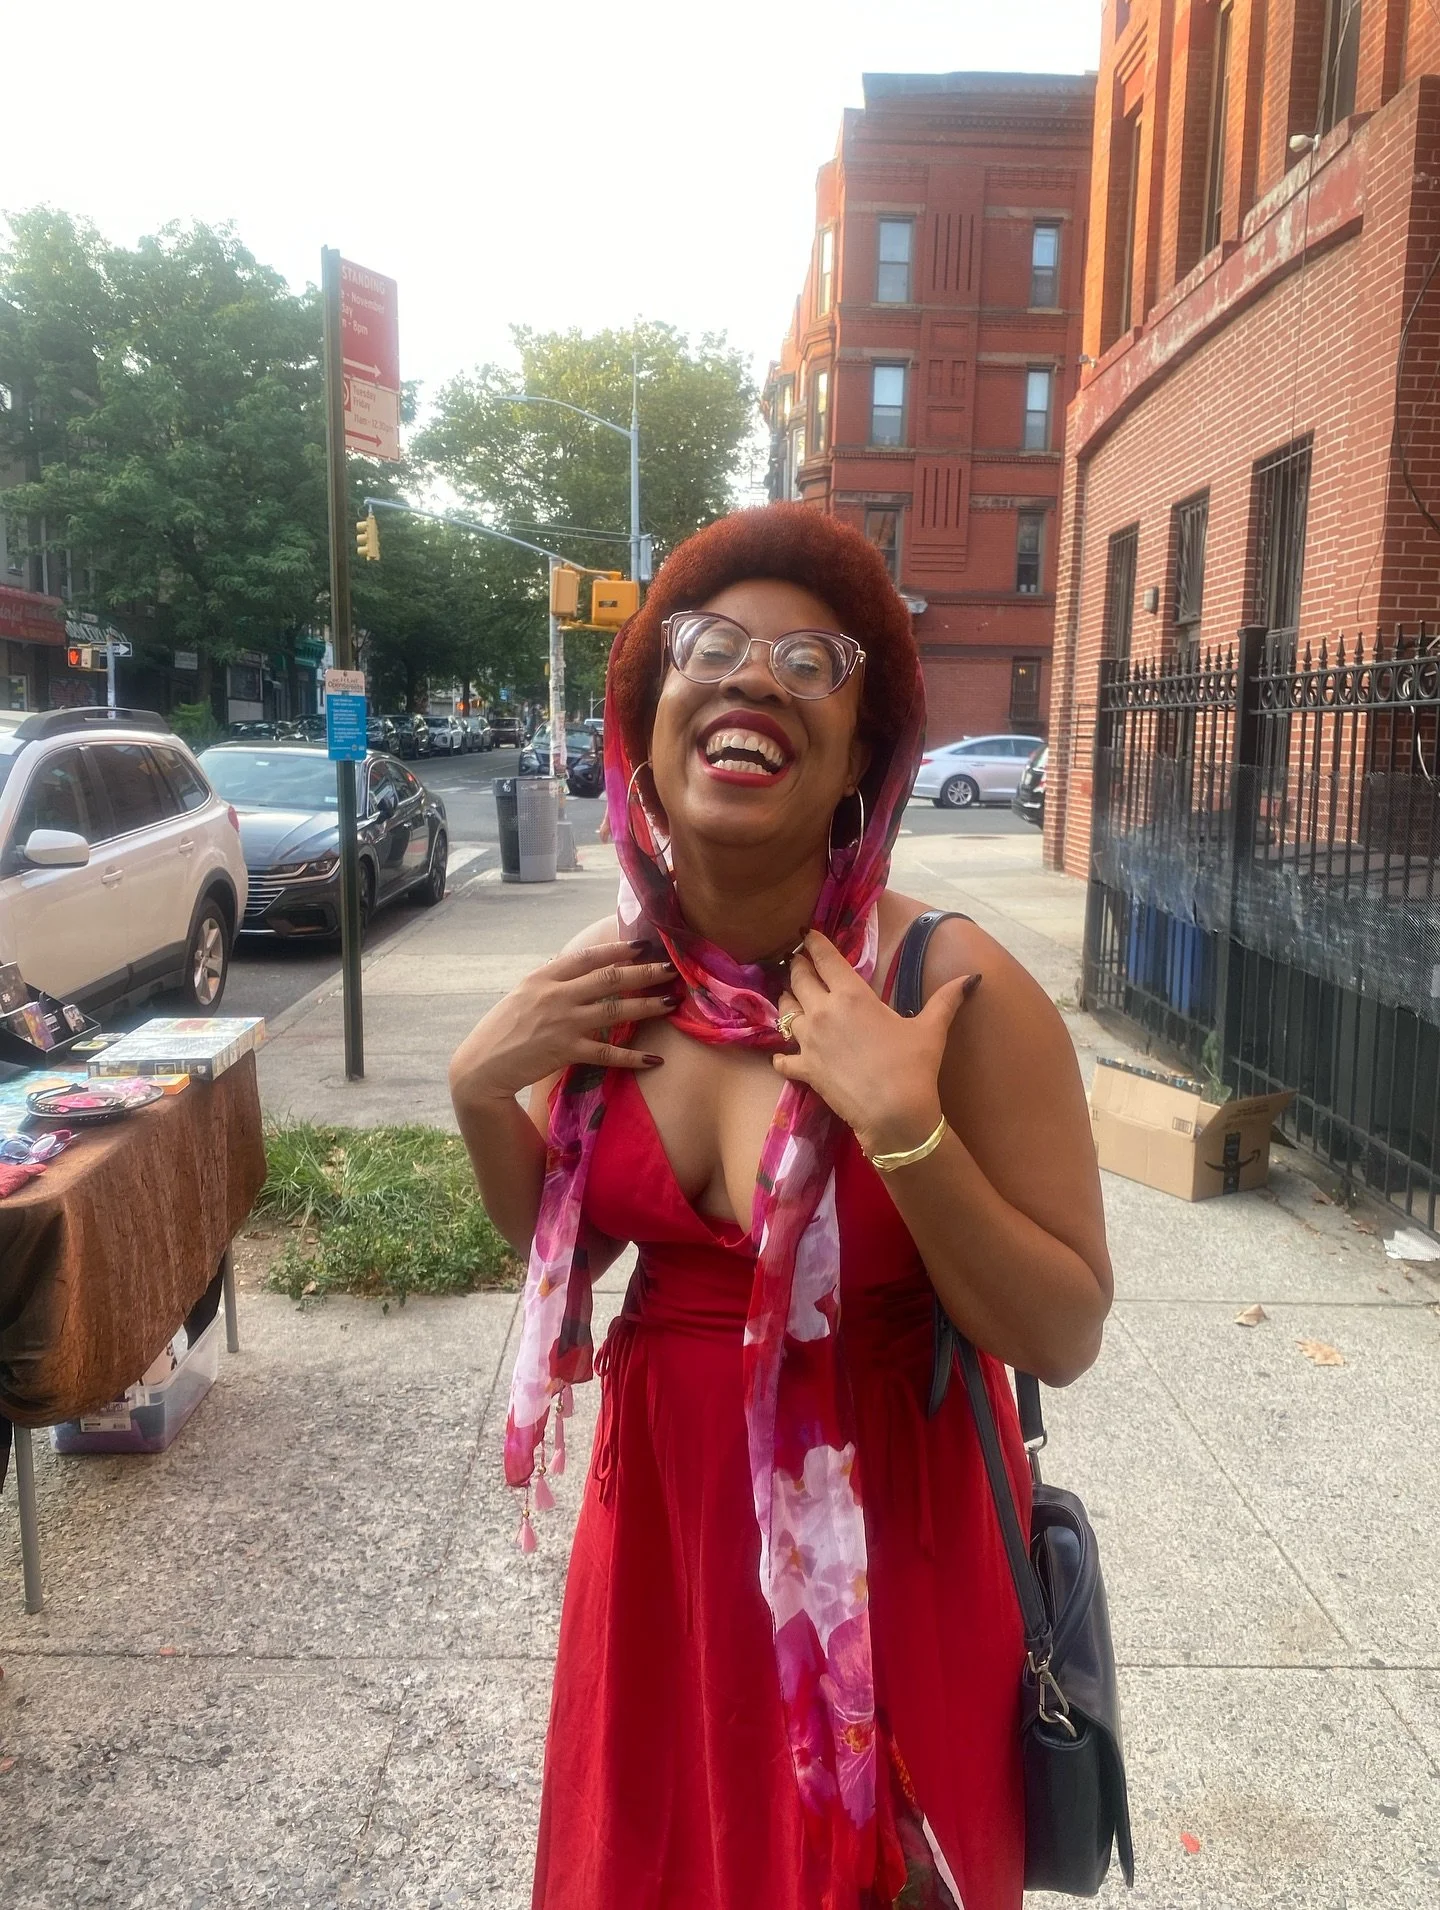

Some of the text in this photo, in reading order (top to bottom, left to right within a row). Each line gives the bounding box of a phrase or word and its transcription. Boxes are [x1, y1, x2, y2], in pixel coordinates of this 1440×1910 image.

[342, 265, 385, 295] STANDING
[351, 291, 385, 315] November
[352, 319, 369, 336] 8pm
[352, 384, 377, 404] Tuesday
[352, 396, 371, 413] Friday
